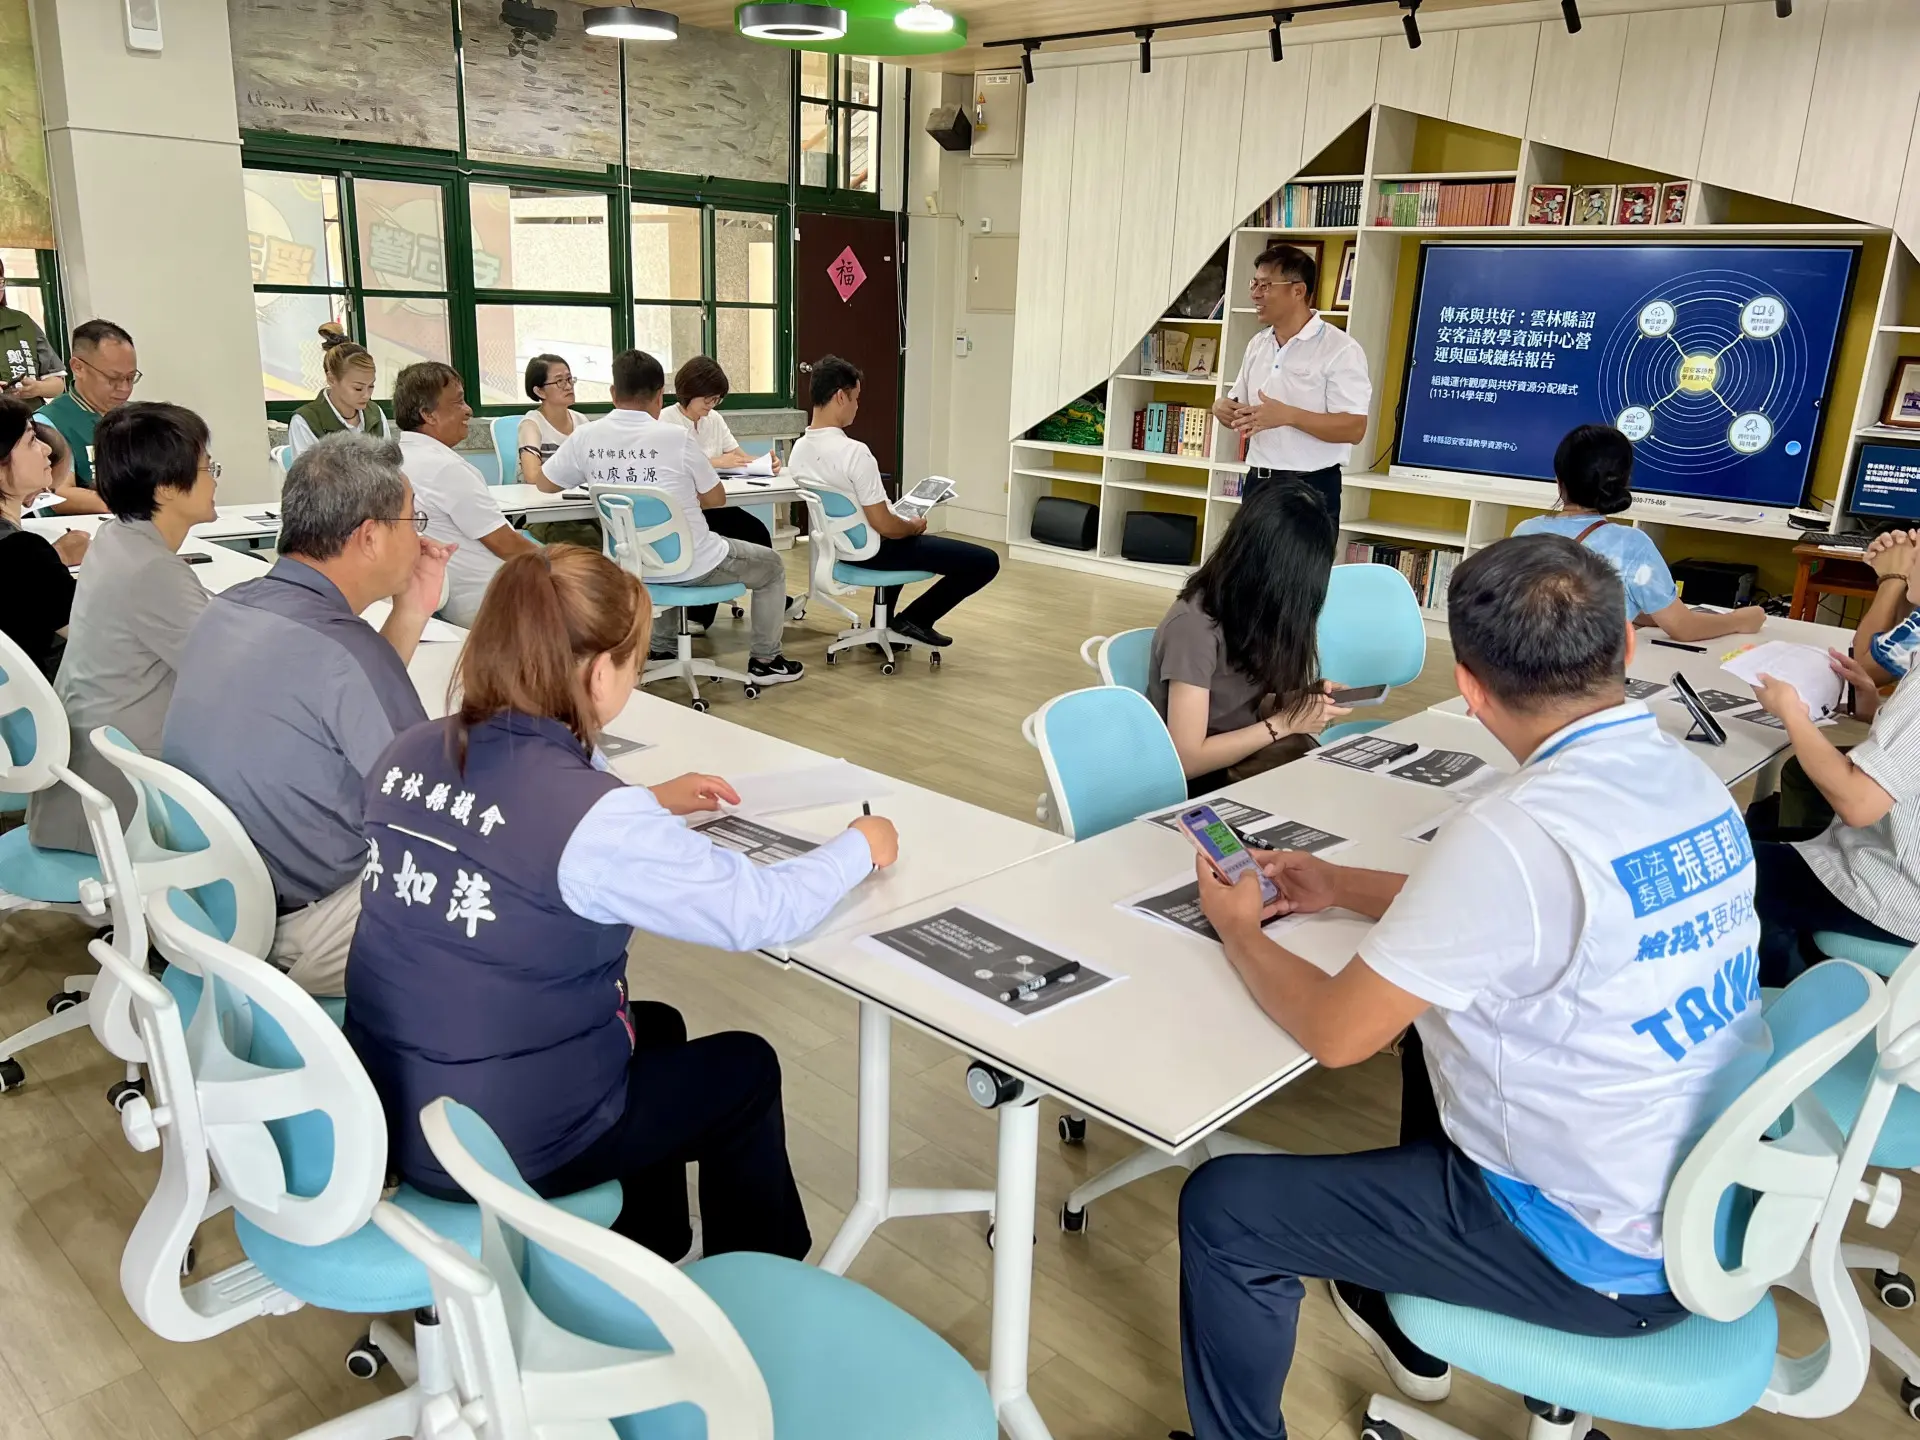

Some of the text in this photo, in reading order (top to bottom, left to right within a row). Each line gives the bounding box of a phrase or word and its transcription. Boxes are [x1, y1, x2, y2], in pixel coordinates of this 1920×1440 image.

[836, 259, 855, 286] 福
[1440, 306, 1596, 329] 傳承與共好：雲林縣詔
[1436, 326, 1592, 350] 安客語教學資源中心營
[1434, 346, 1556, 369] 運與區域鏈結報告
[1429, 388, 1497, 403] (113-114學年度)
[607, 466, 658, 484] 廖高源
[381, 767, 505, 835] 雲林縣議會
[1625, 851, 1668, 885] 立法
[1669, 819, 1742, 893] 張嘉郡
[1638, 876, 1677, 912] 委員
